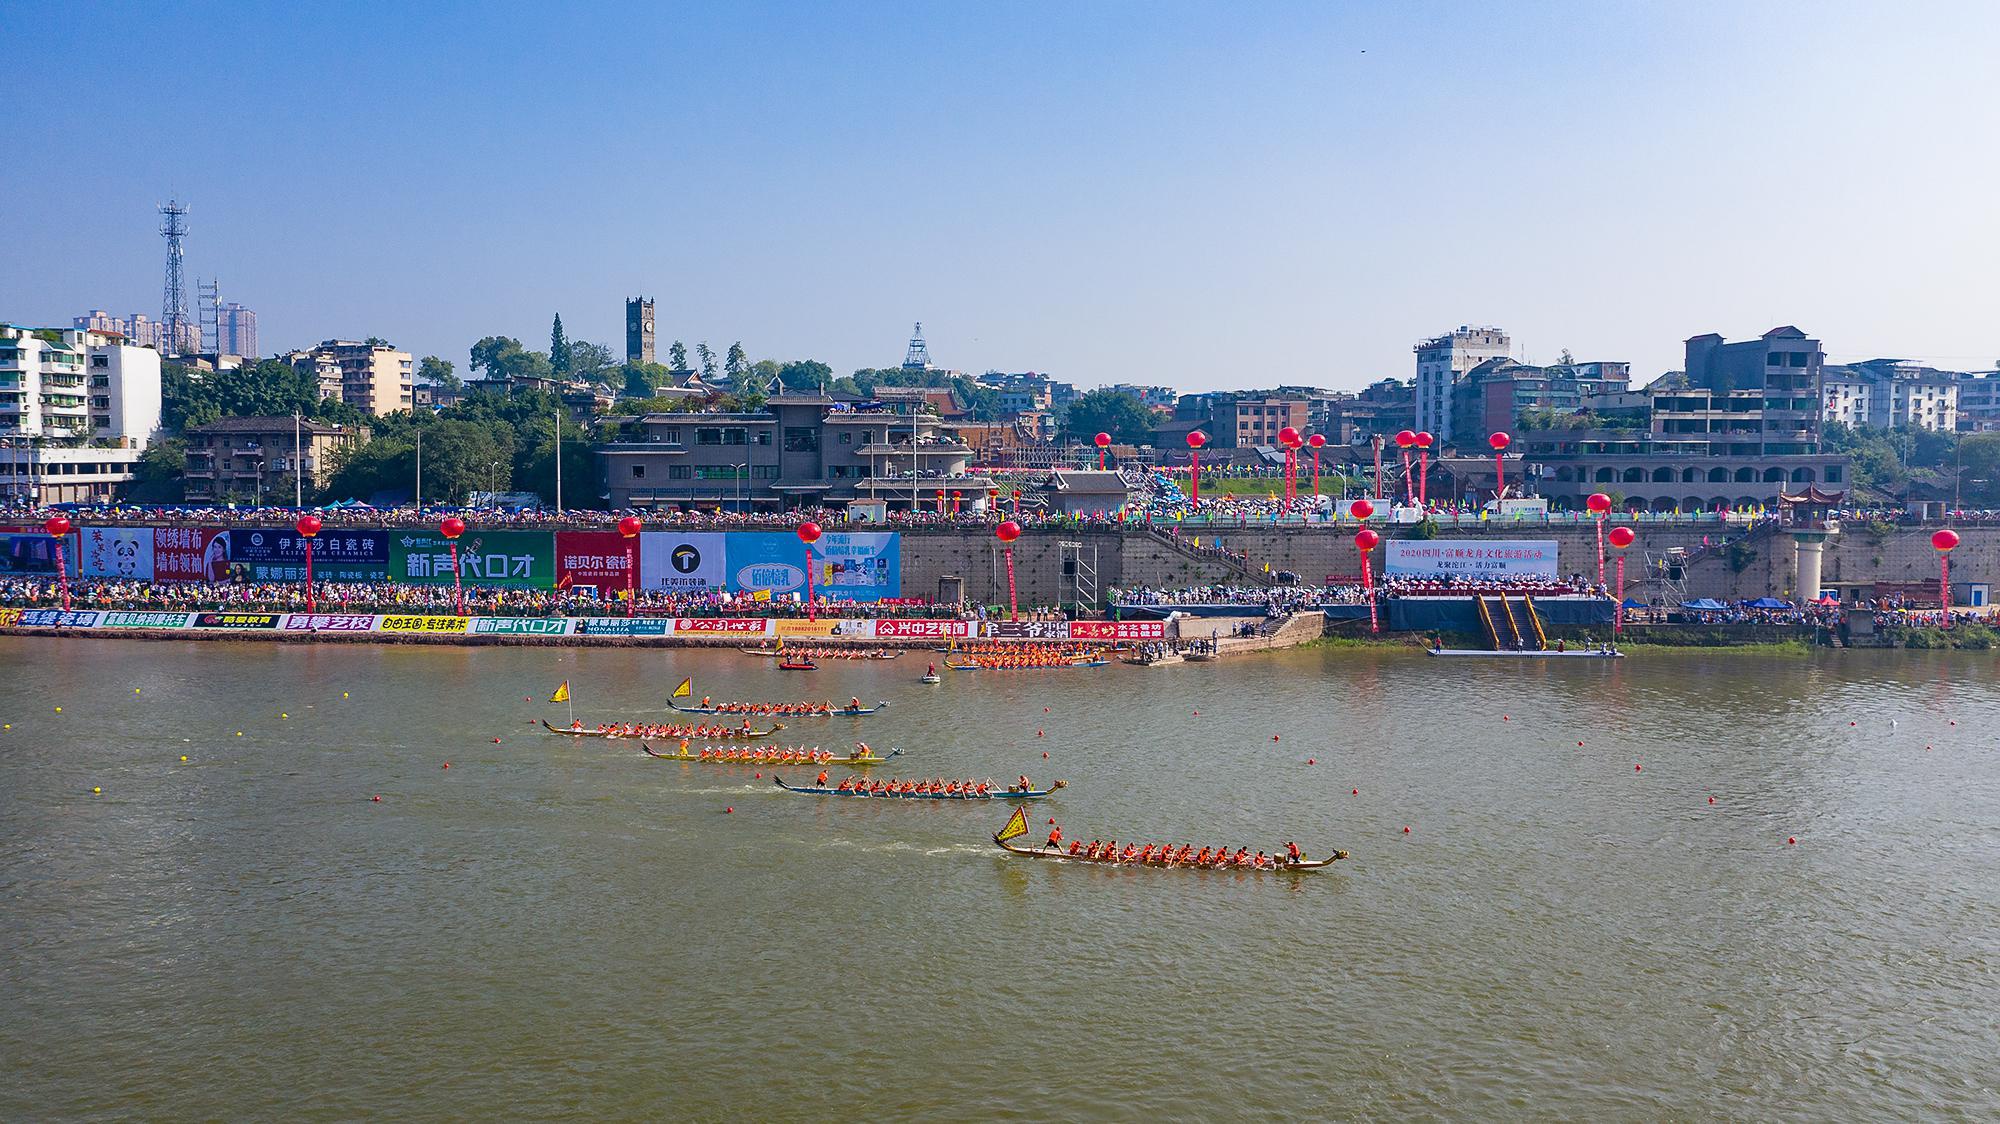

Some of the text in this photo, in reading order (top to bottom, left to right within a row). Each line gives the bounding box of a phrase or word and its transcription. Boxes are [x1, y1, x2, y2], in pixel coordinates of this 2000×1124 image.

[155, 528, 202, 549] 领绣墙布
[279, 538, 375, 551] 伊莉莎白瓷砖
[1400, 548, 1543, 559] 2020四川·富顺龙舟文化旅游活动
[156, 552, 202, 573] 墙布领袖
[407, 553, 535, 578] 新声代口才
[106, 613, 187, 625] 富顺贝纳利摩托车
[477, 619, 566, 633] 新声代口才
[898, 622, 966, 635] 兴中艺装饰
